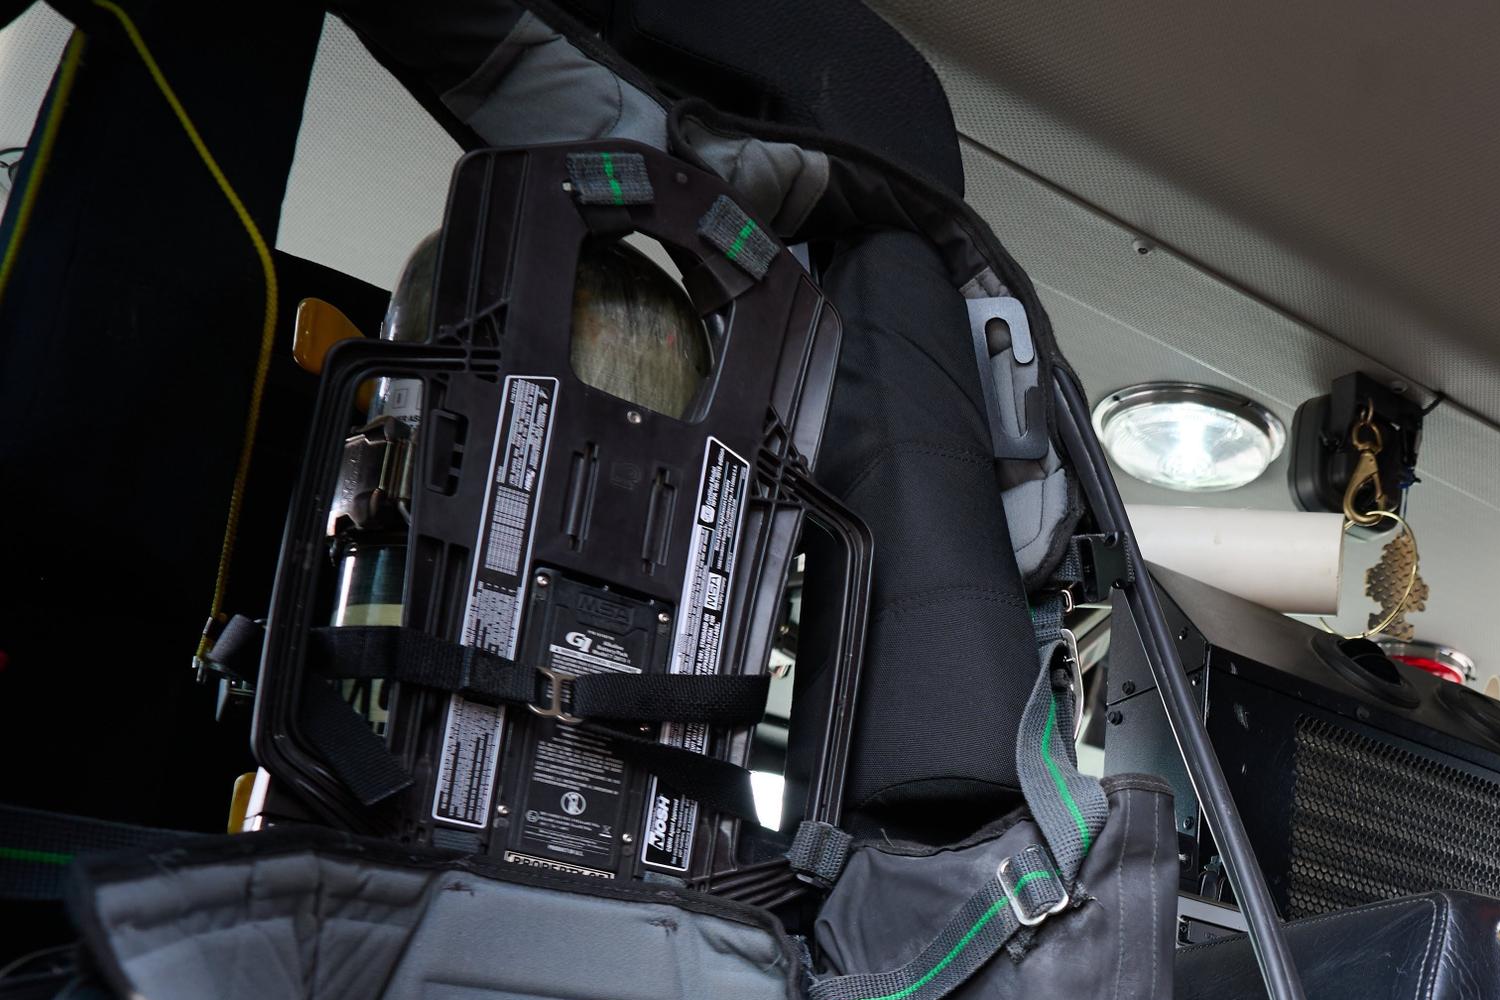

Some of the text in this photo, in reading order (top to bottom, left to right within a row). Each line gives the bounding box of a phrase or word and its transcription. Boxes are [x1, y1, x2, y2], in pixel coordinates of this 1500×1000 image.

[707, 576, 719, 607] MSA
[565, 631, 593, 653] G1
[648, 795, 670, 851] NIOSH
